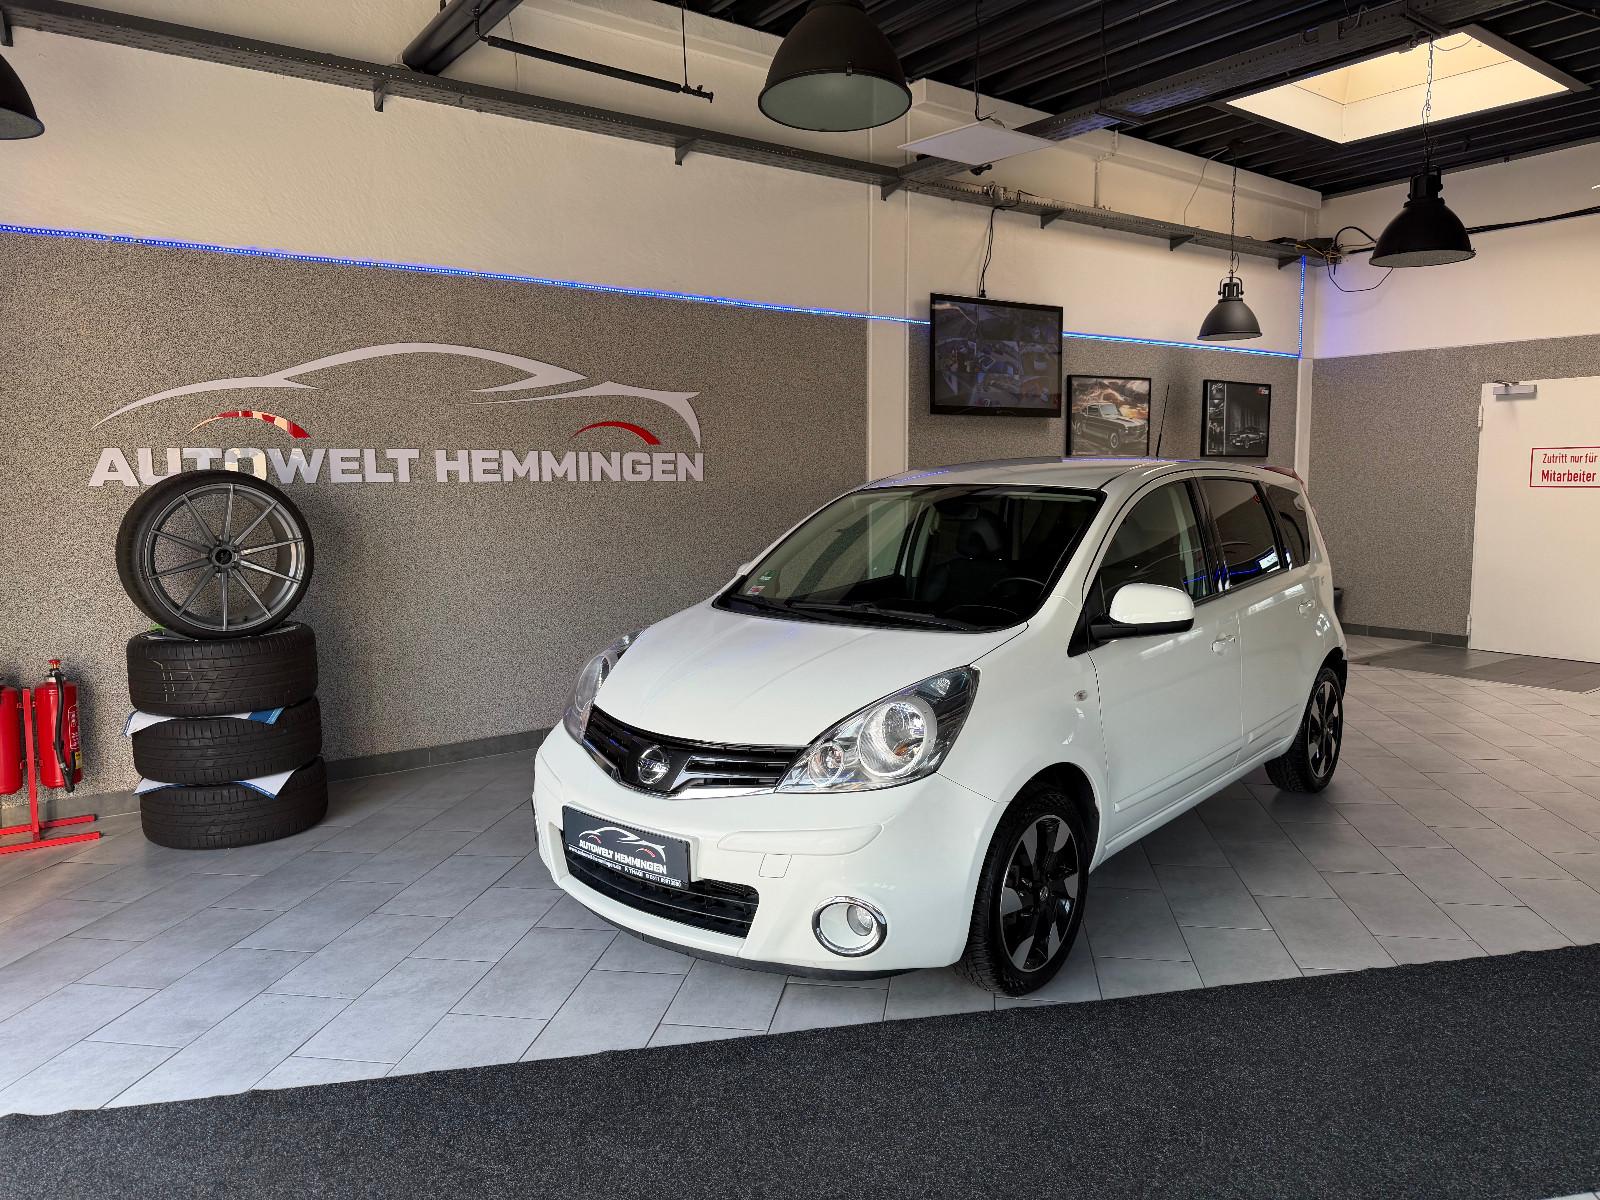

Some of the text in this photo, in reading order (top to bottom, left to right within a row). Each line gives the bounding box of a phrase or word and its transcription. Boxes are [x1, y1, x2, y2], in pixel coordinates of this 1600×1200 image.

[88, 448, 704, 487] AUTOWELT HEMMINGEN
[1542, 452, 1598, 463] Zutritt nur für
[1541, 469, 1597, 482] Mitarbeiter
[579, 839, 614, 859] AUTOWELT
[614, 852, 667, 875] HEMMINGEN
